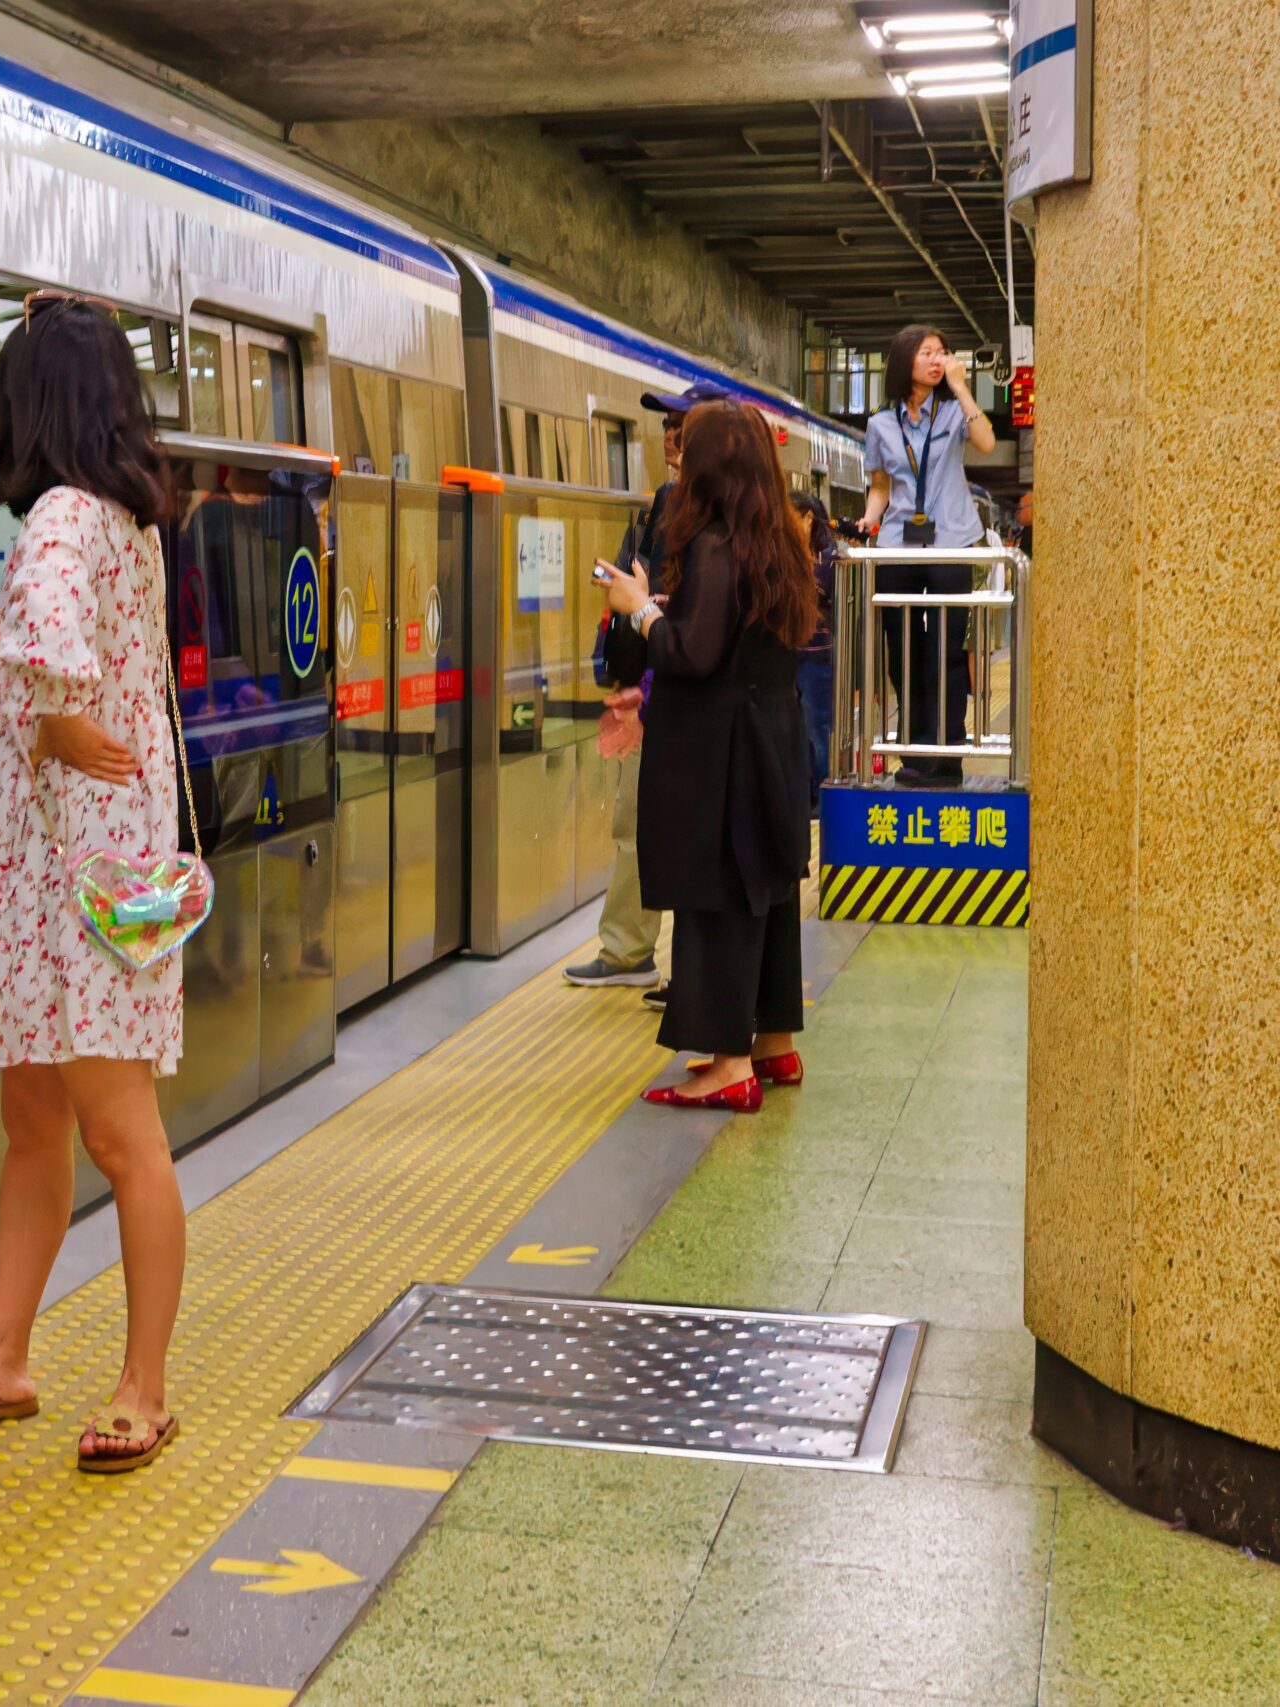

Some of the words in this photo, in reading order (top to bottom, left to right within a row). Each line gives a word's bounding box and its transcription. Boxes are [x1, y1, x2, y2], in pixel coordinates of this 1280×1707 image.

[291, 582, 314, 645] 12
[867, 804, 1008, 848] 禁止攀爬
